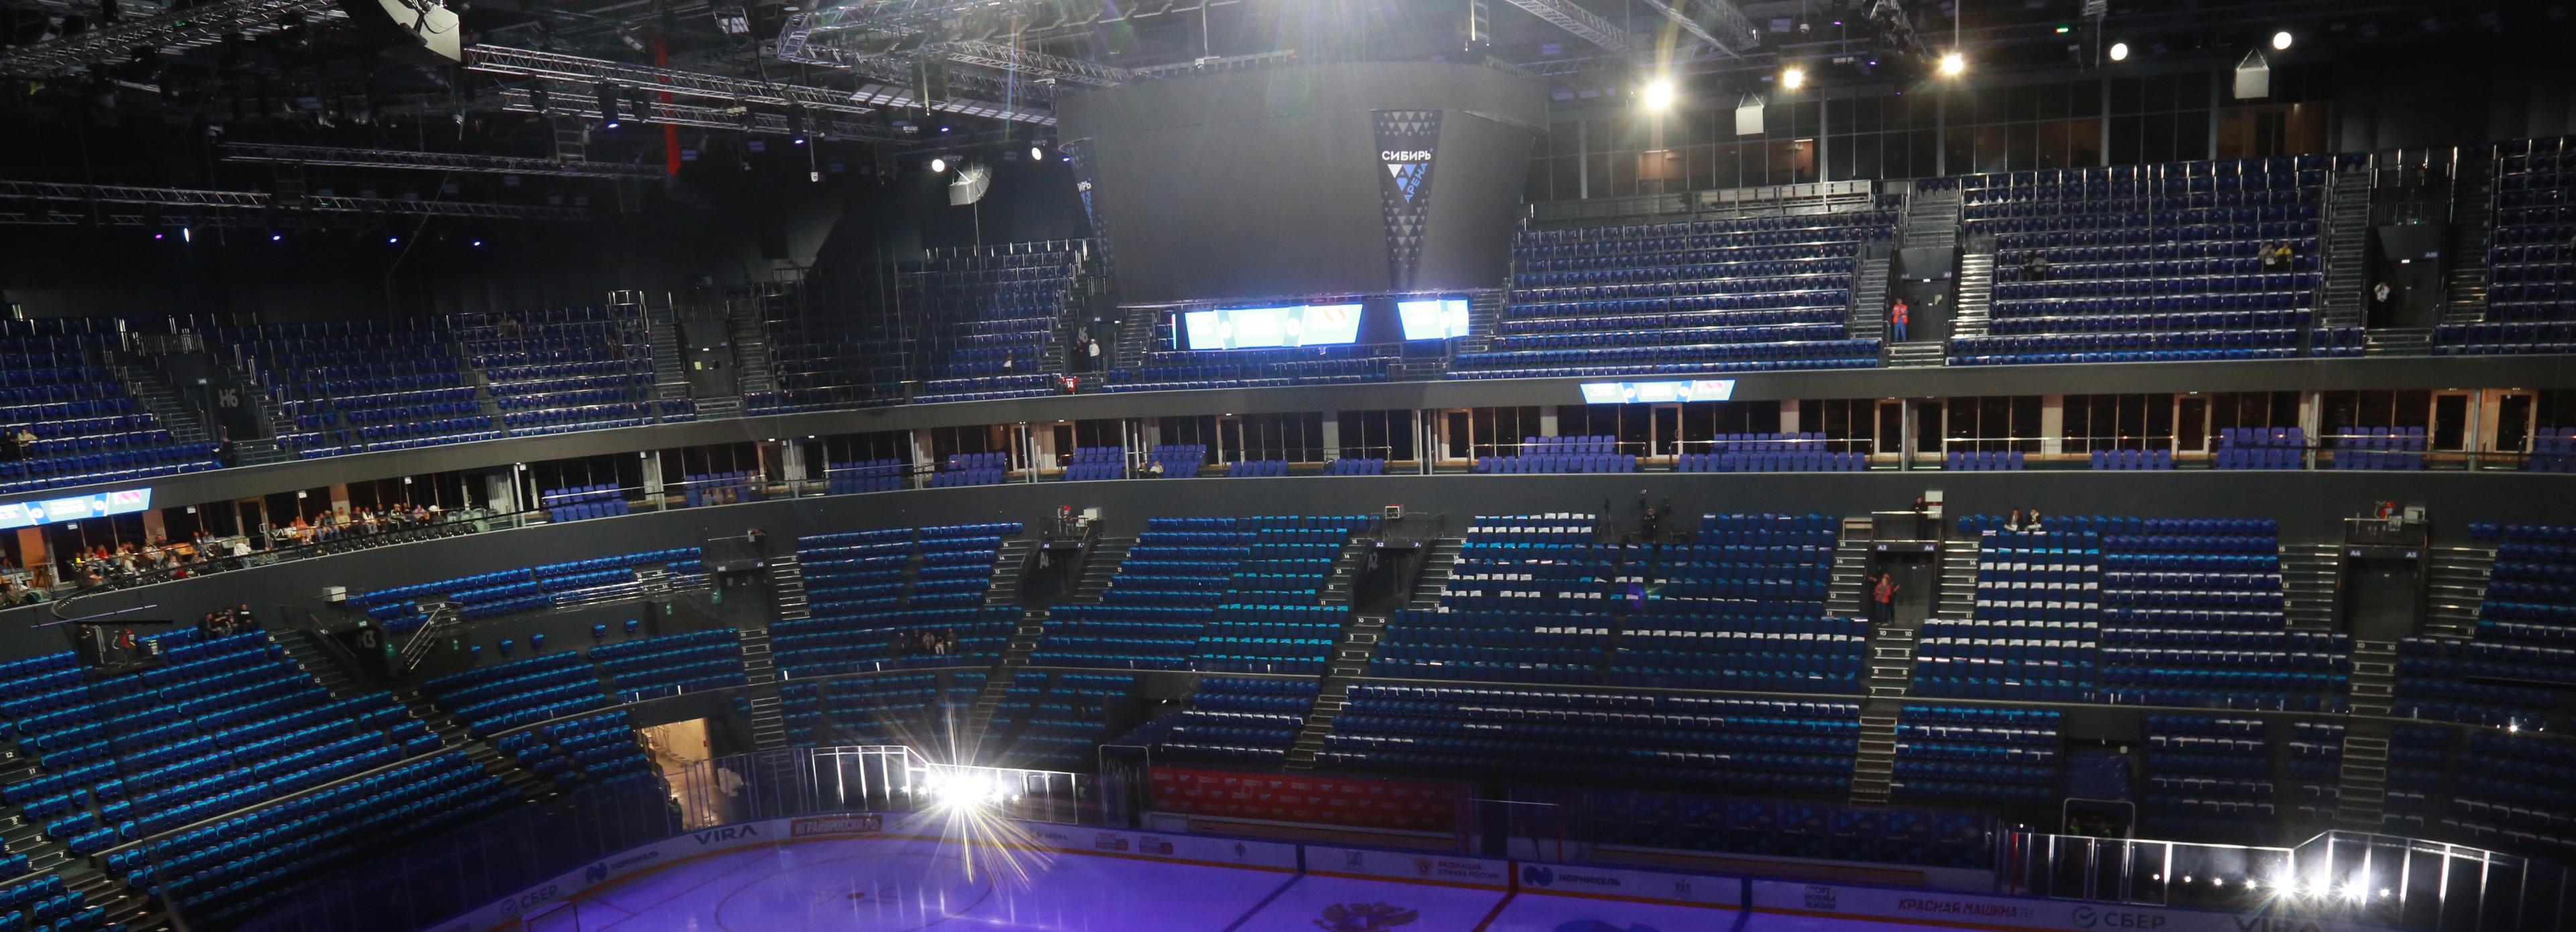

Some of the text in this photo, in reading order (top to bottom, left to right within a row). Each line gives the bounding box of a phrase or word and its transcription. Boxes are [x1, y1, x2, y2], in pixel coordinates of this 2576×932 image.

[1382, 150, 1431, 161] СИБИРЬ
[1404, 163, 1428, 203] АРЕНА
[694, 825, 757, 845] VIRA
[1559, 874, 1621, 886] НОРНИКЕЛЬ
[521, 884, 558, 909] СБЕР
[1898, 898, 1962, 914] КРАСНАЯ
[1963, 902, 2017, 918] МАШИНА
[2104, 912, 2167, 930] СБЕР
